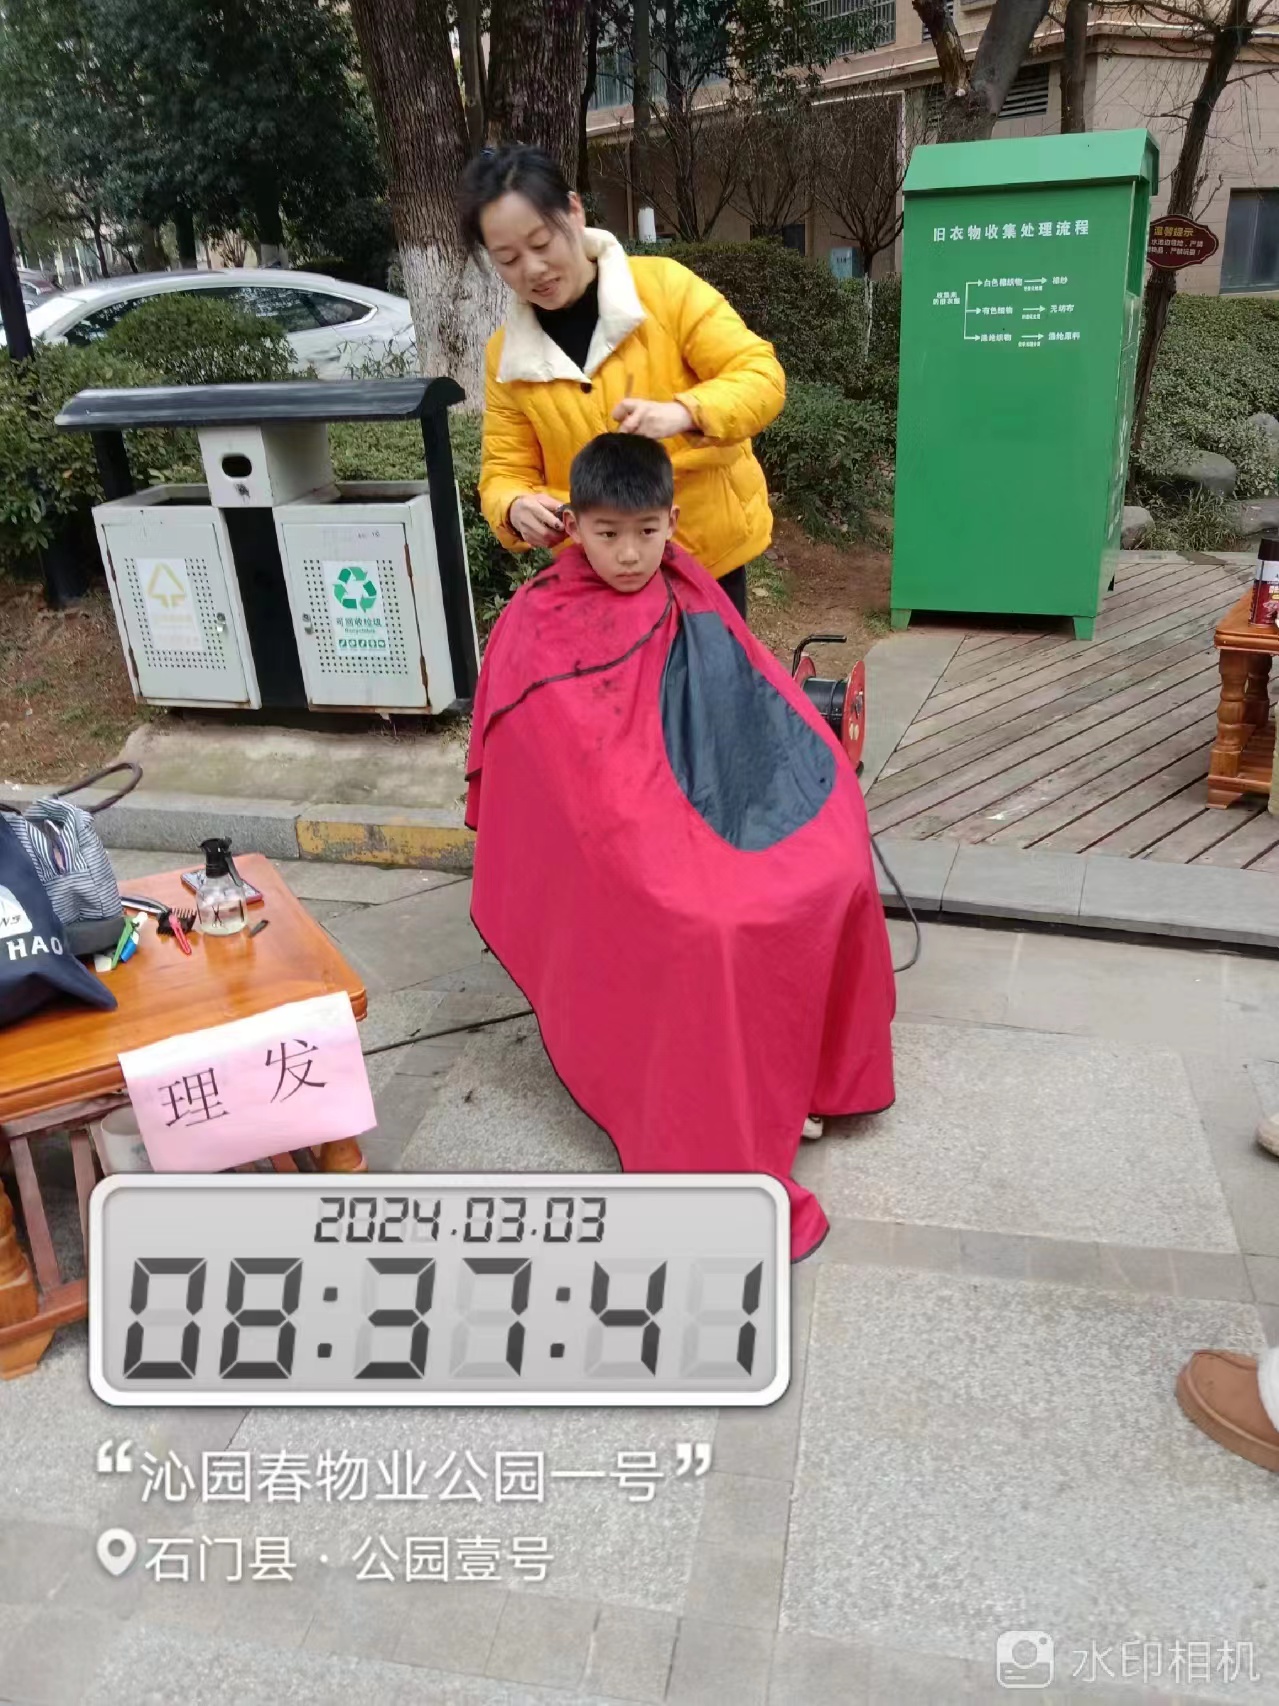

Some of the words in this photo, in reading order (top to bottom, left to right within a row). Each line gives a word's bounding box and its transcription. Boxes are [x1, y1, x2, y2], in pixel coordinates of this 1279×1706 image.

[933, 219, 1089, 242] 旧衣物收集处理流程
[1154, 226, 1194, 237] 温馨提示
[1050, 304, 1075, 313] 无纺布
[336, 617, 382, 628] 可回收垃圾
[6, 935, 64, 961] HAO
[158, 1039, 328, 1127] 理发
